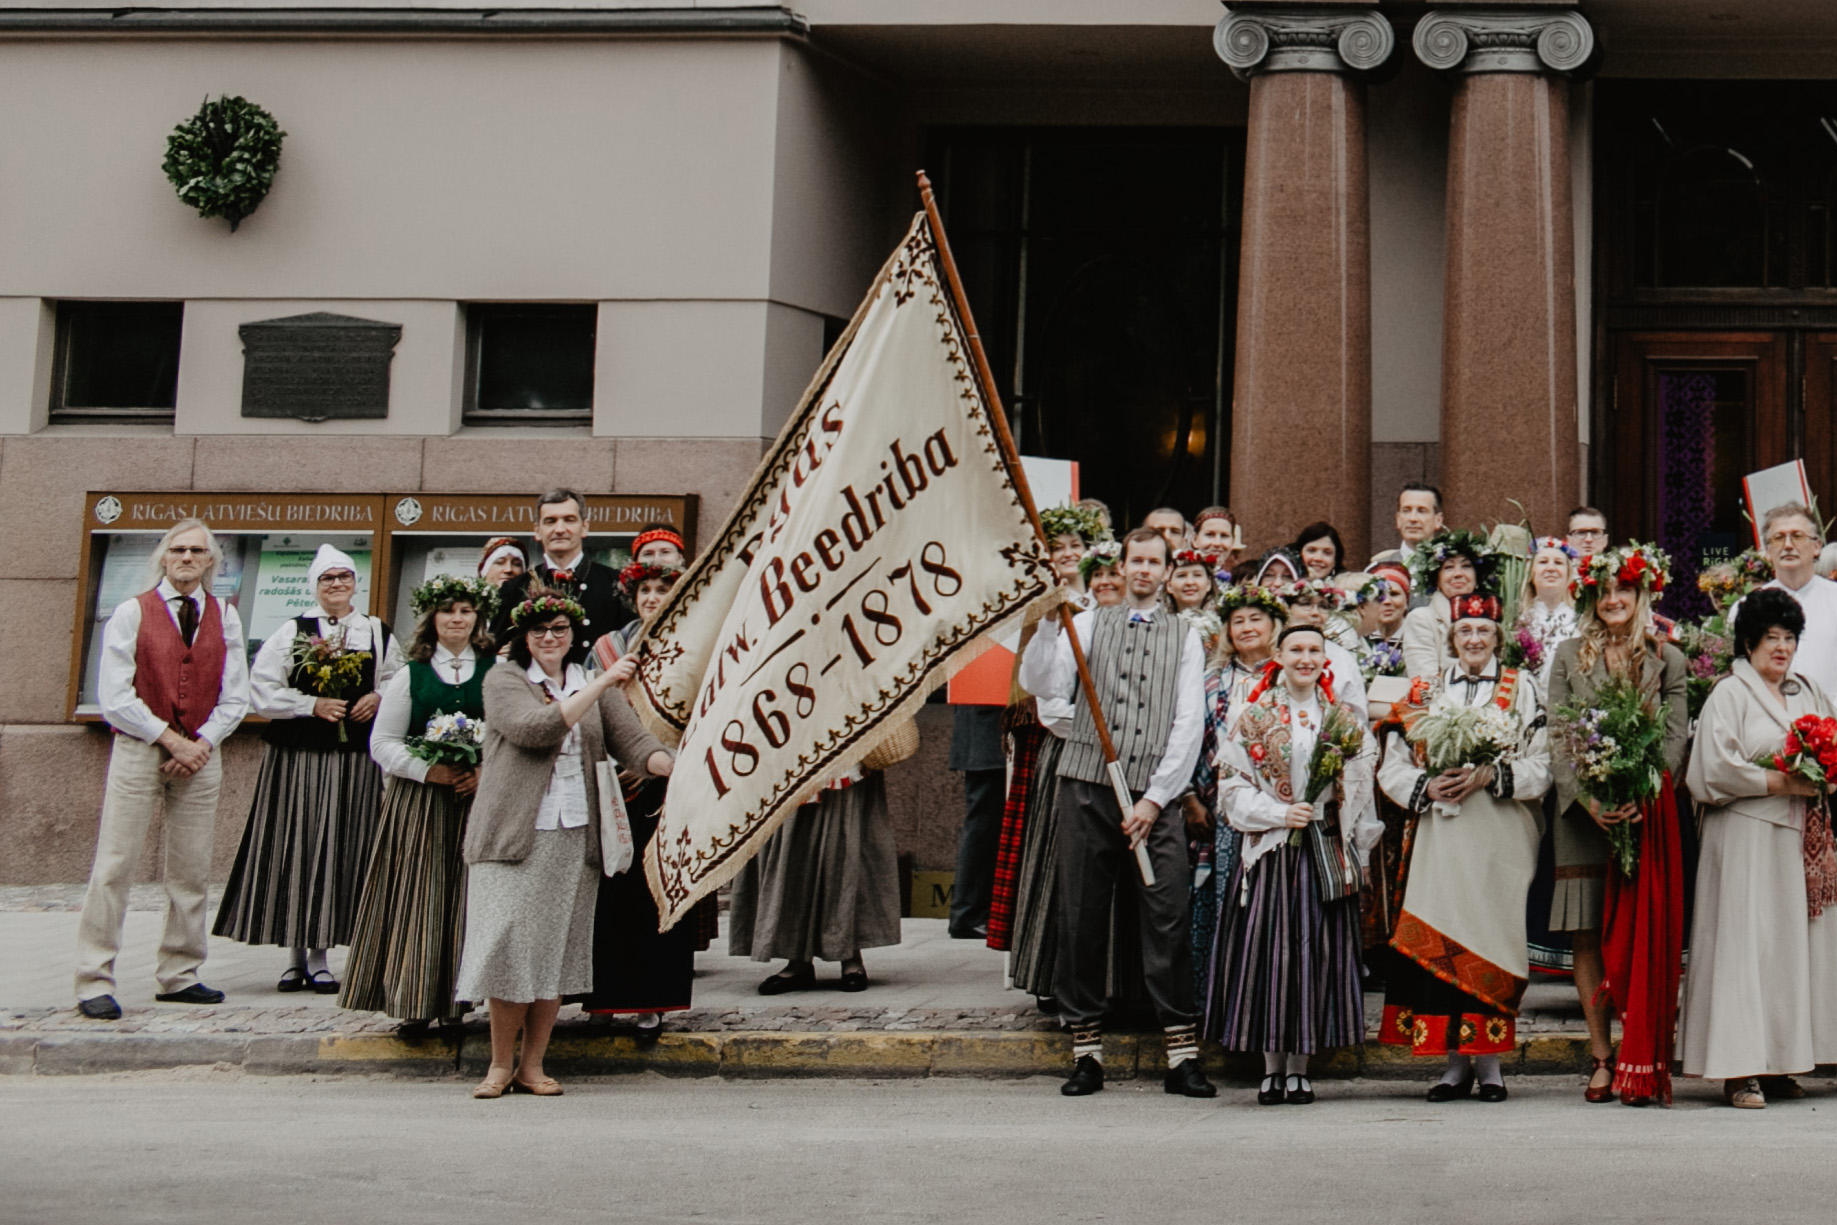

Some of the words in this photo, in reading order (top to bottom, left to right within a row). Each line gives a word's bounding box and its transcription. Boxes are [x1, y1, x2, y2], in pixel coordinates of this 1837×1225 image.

[287, 504, 373, 522] BIEDRĪBA
[432, 505, 487, 522] RĪGAS
[492, 506, 536, 522] LATV
[586, 504, 673, 523] BIEDRĪBA
[760, 427, 958, 629] Beedriba
[1703, 547, 1729, 556] LIVE
[272, 575, 310, 584] Vasara
[259, 586, 303, 595] radošās
[286, 598, 318, 607] Pēter
